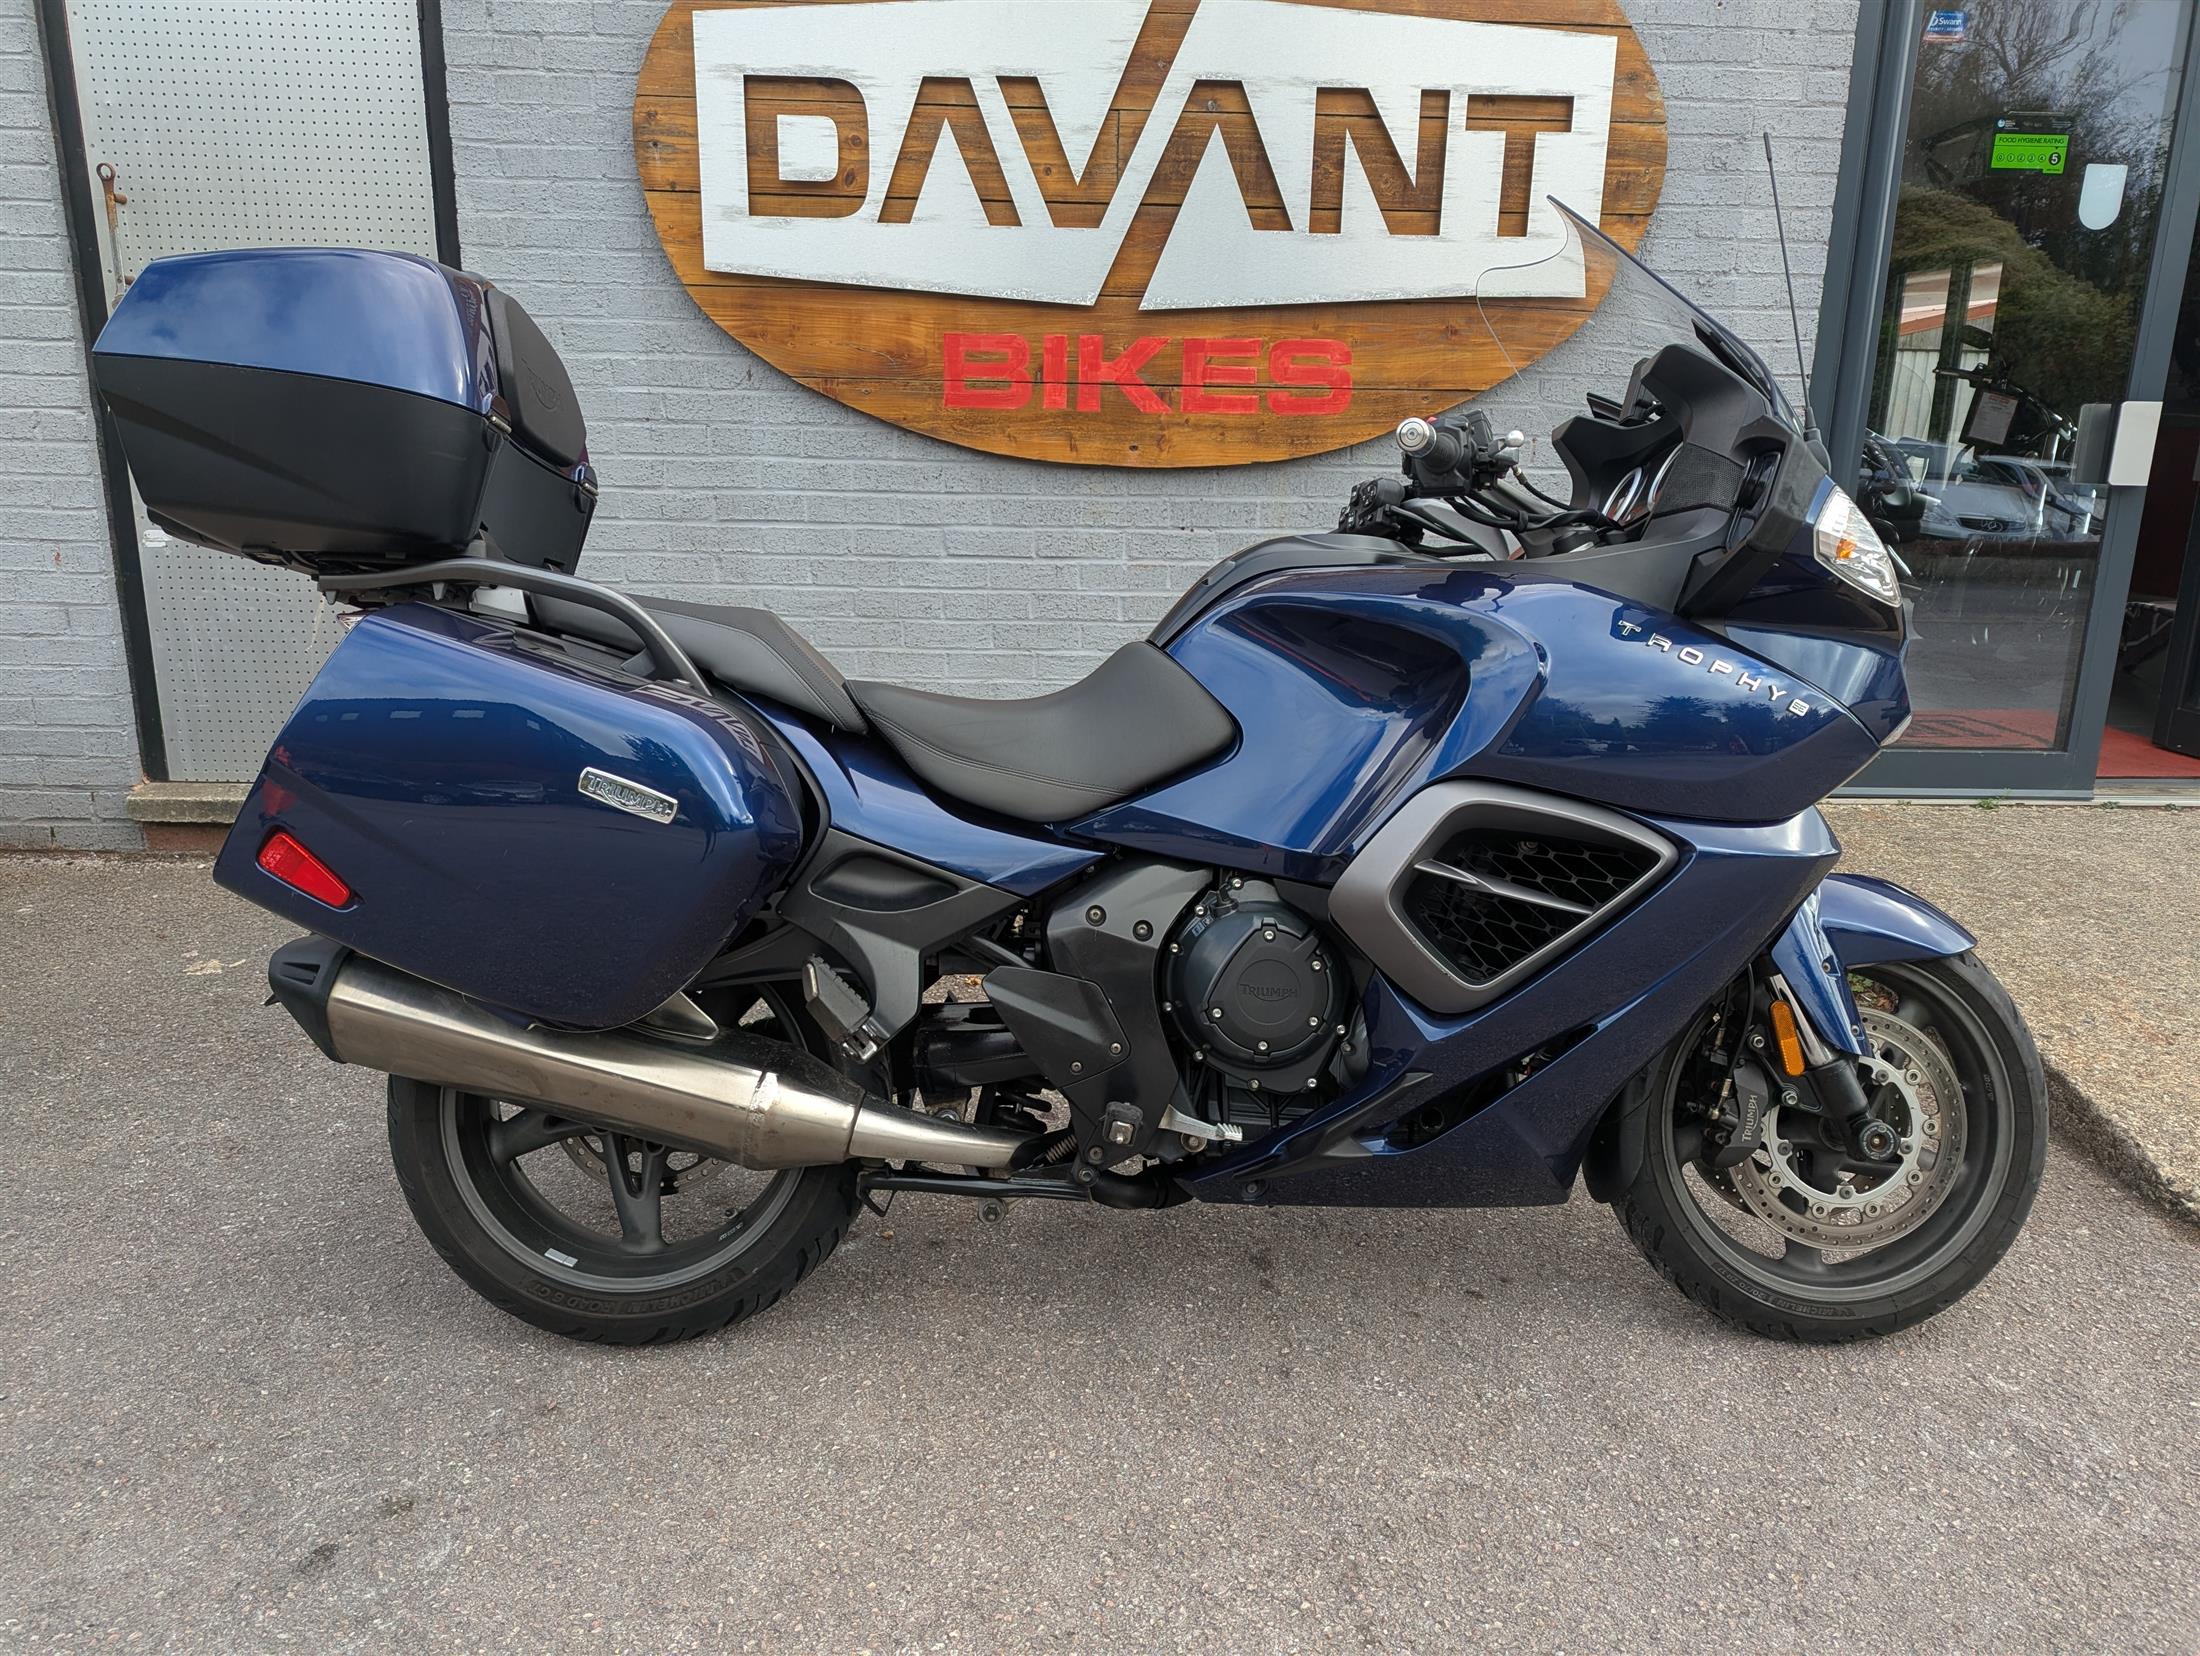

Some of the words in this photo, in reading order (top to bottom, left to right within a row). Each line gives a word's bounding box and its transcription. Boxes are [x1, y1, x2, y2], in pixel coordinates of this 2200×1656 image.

[743, 73, 1575, 237] DAVANT
[2042, 137, 2065, 145] RATING
[943, 332, 1353, 416] BIKES
[1617, 619, 1788, 702] TROPHY
[587, 774, 672, 817] TRIUMPH
[1239, 983, 1298, 1001] TRIUMPH
[1741, 1094, 1758, 1142] TRIUMPH
